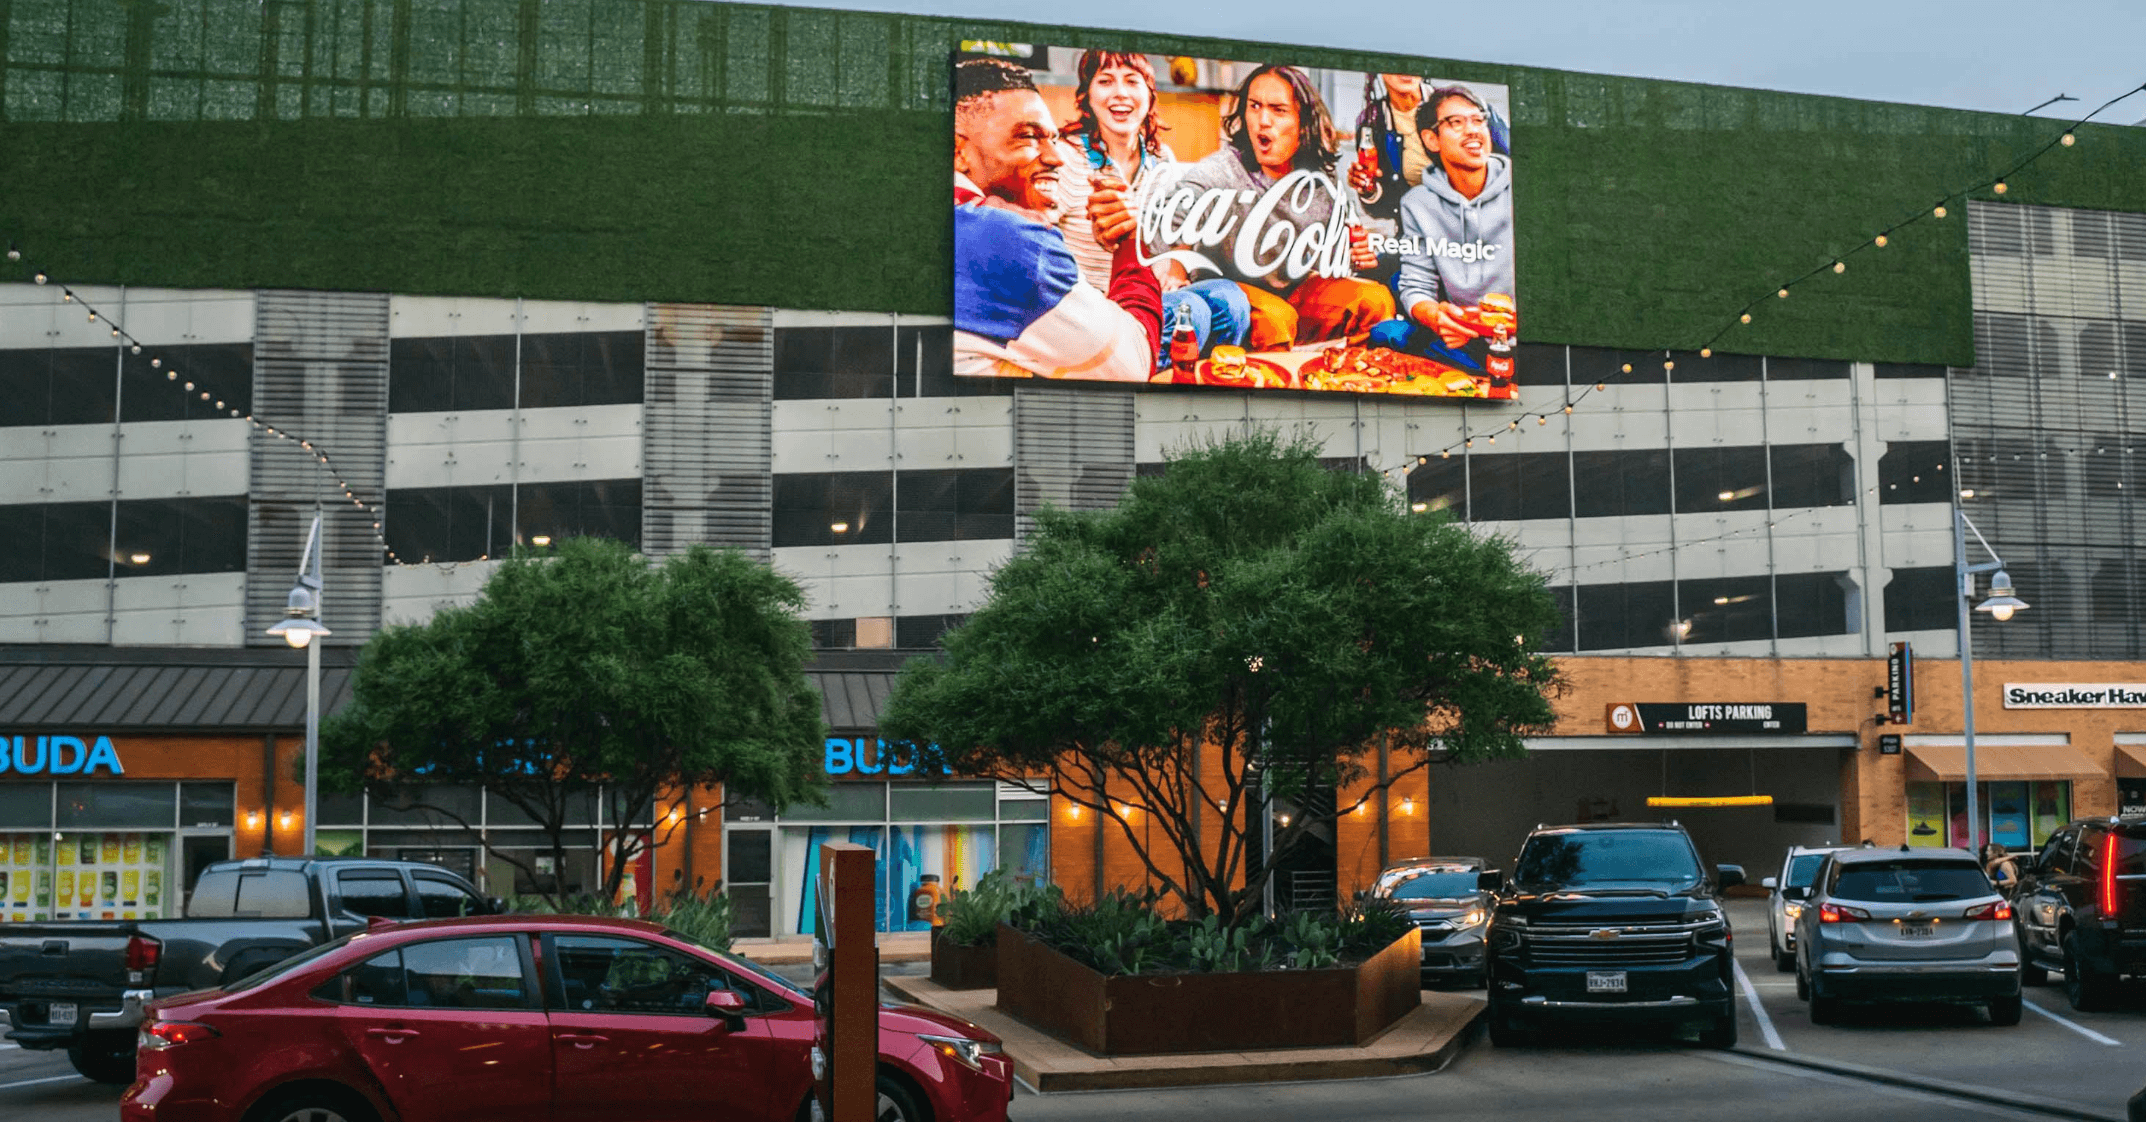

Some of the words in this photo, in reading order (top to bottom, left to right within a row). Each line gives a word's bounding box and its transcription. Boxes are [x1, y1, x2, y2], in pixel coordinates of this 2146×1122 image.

[1367, 233, 1421, 255] Real
[1426, 237, 1495, 263] Magic
[2009, 688, 2106, 704] Sneaker
[1688, 705, 1723, 720] LOFTS
[1725, 705, 1773, 720] PARKING
